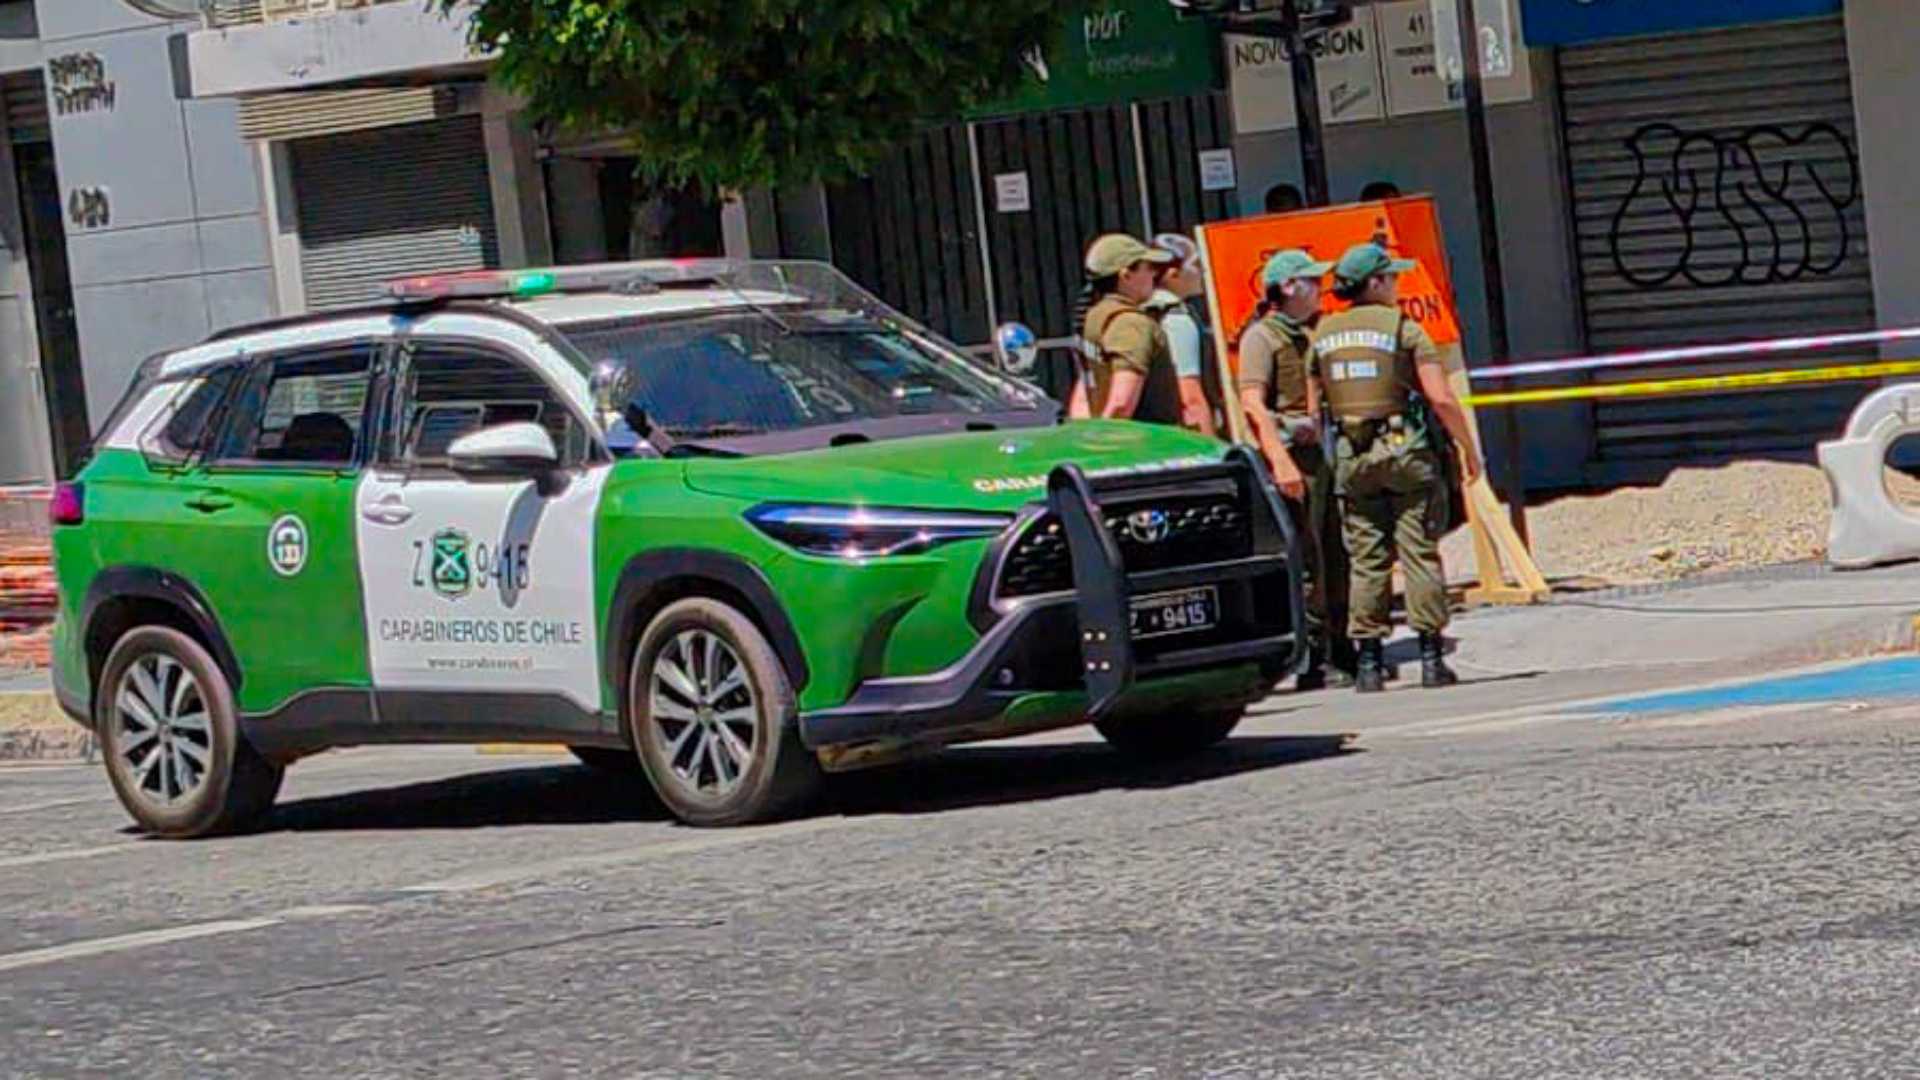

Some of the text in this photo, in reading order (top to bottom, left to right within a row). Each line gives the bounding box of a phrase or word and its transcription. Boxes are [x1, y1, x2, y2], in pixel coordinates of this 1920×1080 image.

[412, 540, 425, 587] Z
[1162, 605, 1206, 628] 9415
[379, 618, 582, 644] CARABINEROS DE CHILE
